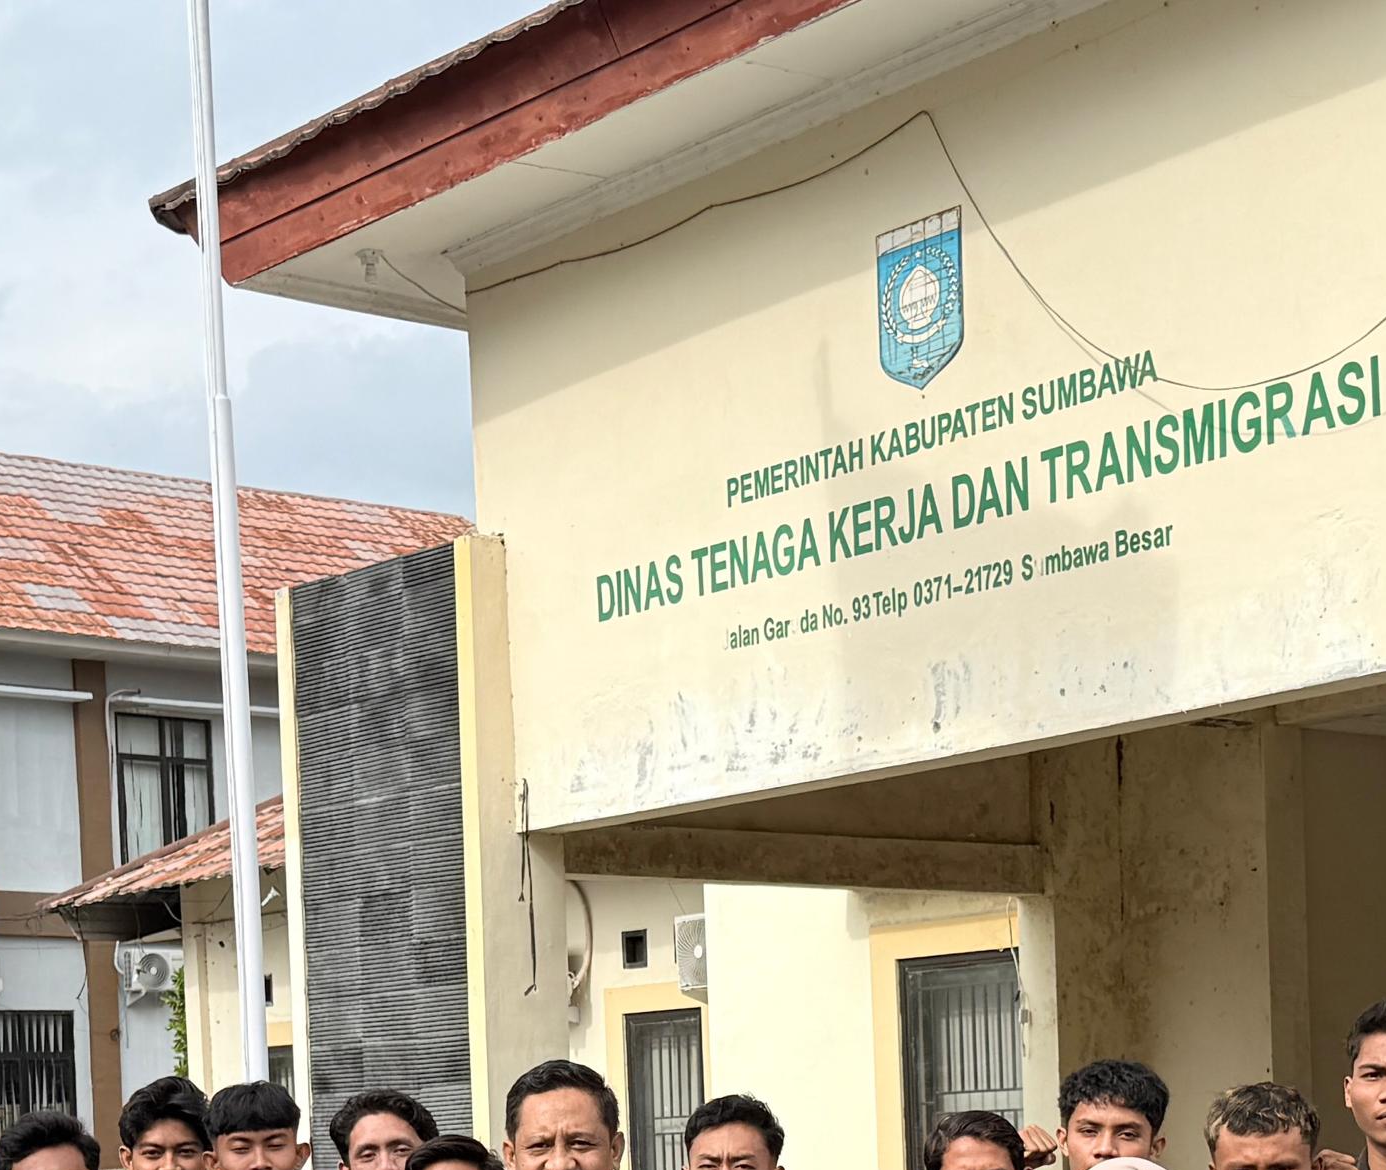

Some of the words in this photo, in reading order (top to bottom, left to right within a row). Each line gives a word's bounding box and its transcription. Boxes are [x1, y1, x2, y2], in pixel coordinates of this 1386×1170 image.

[596, 554, 684, 623] DINAS
[691, 518, 822, 594] TENAGA
[828, 484, 944, 563] KERJA
[951, 457, 1030, 530] DAN
[1040, 355, 1382, 503] TRANSMIGRASI
[726, 438, 864, 508] PEMERINTAH
[871, 397, 1015, 463] KABUPATEN
[1021, 349, 1159, 421] SUMBAWA
[724, 624, 760, 650] alan
[763, 609, 818, 642] Garda
[822, 603, 849, 629] No.
[852, 594, 872, 622] 93
[872, 587, 908, 617] Telp
[1021, 540, 1110, 581] Smbawa
[1115, 524, 1173, 558] Besar
